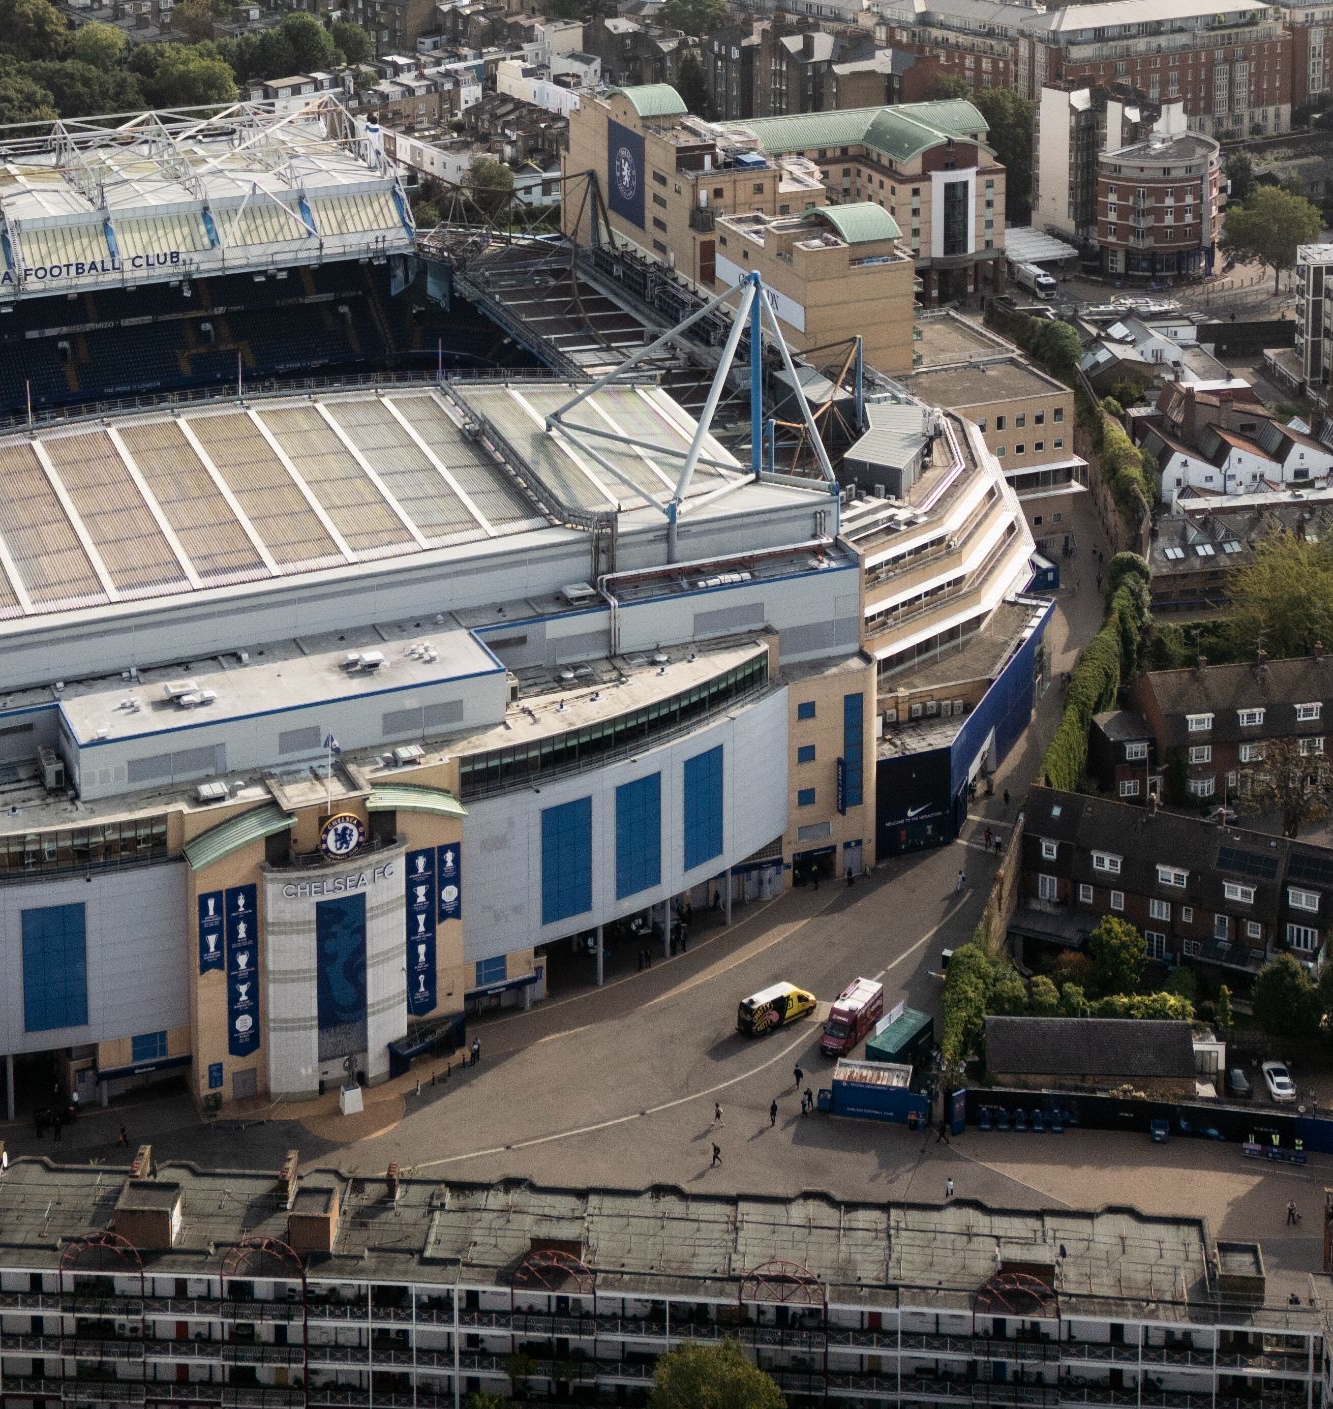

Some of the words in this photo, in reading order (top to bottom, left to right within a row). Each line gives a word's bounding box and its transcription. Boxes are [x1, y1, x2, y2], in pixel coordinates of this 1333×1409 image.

[23, 259, 121, 282] FOOTBALL
[132, 251, 180, 269] CLUB
[327, 814, 358, 831] CHELSEA
[282, 873, 368, 899] CHELSEA
[373, 862, 395, 884] FC
